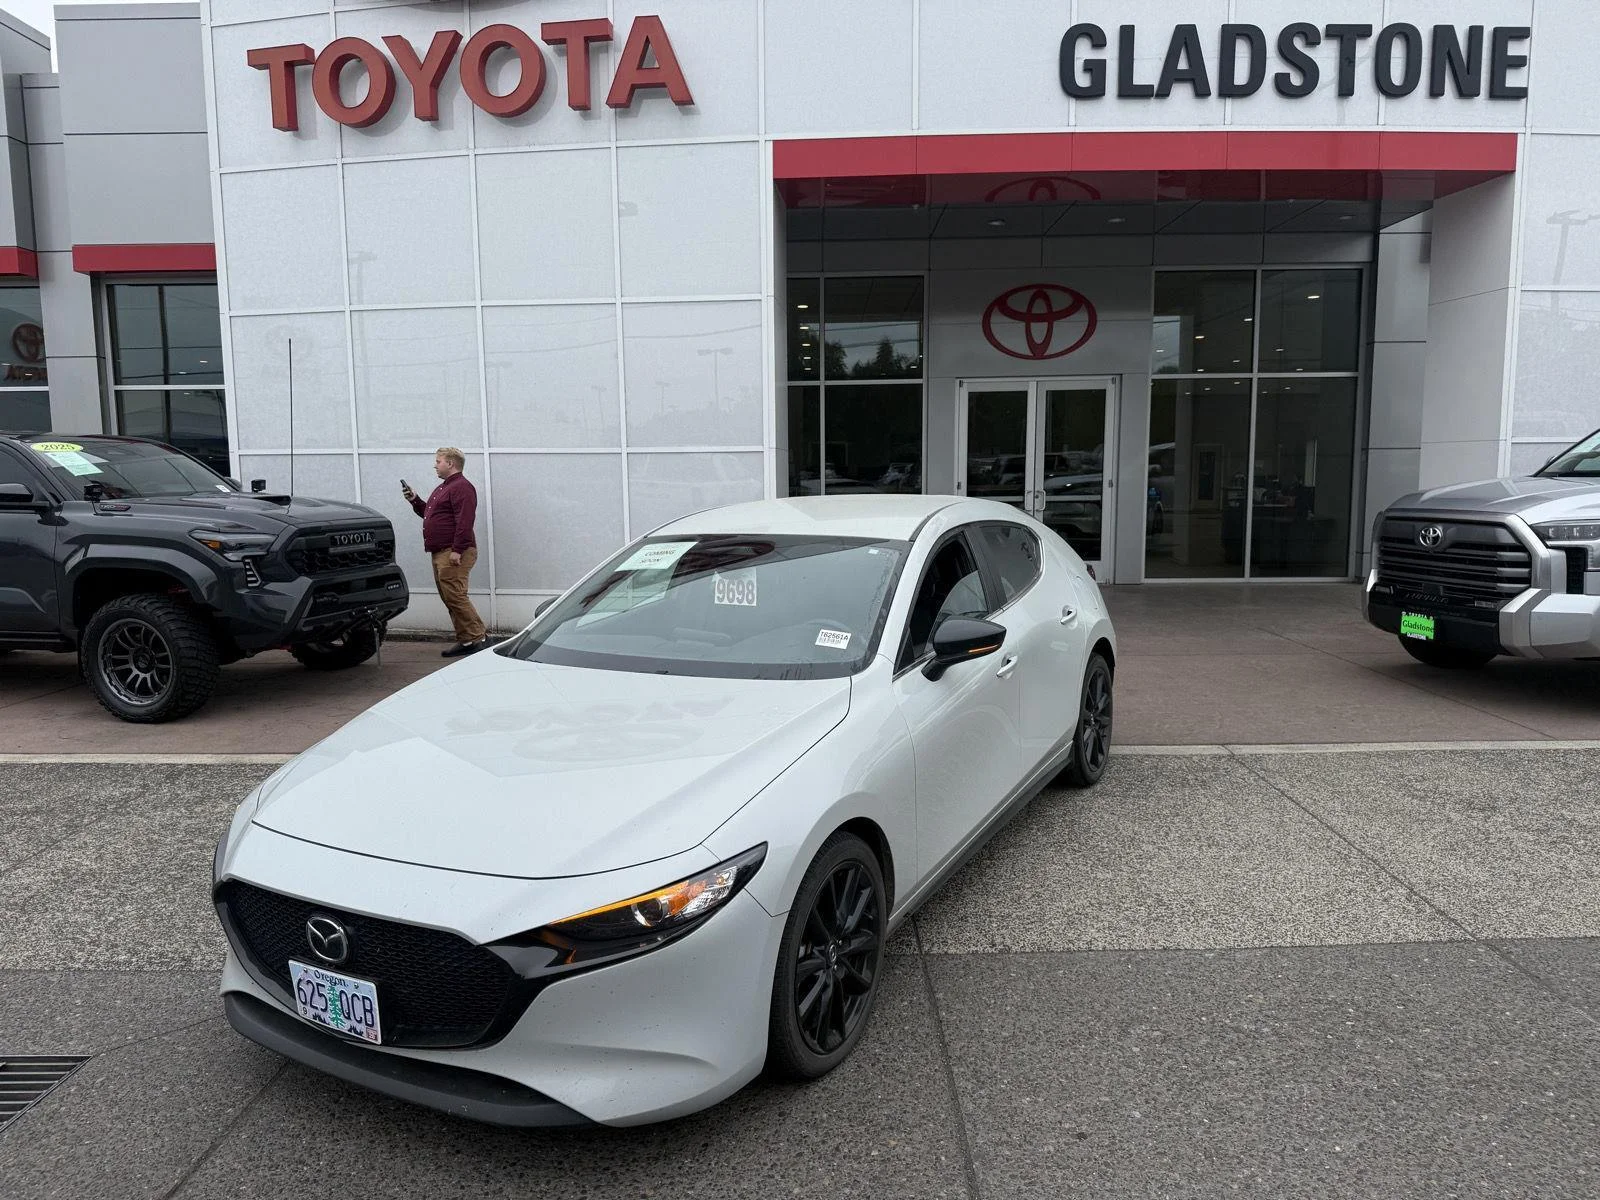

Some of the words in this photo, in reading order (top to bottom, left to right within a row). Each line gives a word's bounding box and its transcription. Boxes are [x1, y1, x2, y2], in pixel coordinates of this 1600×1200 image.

[247, 15, 695, 132] TOYOTA
[1059, 22, 1531, 99] GLADSTONE
[334, 532, 372, 545] TOYOTA
[717, 579, 755, 604] 9698
[1402, 619, 1434, 633] Gladstone
[297, 977, 328, 1012] 625
[340, 989, 375, 1028] QCB
